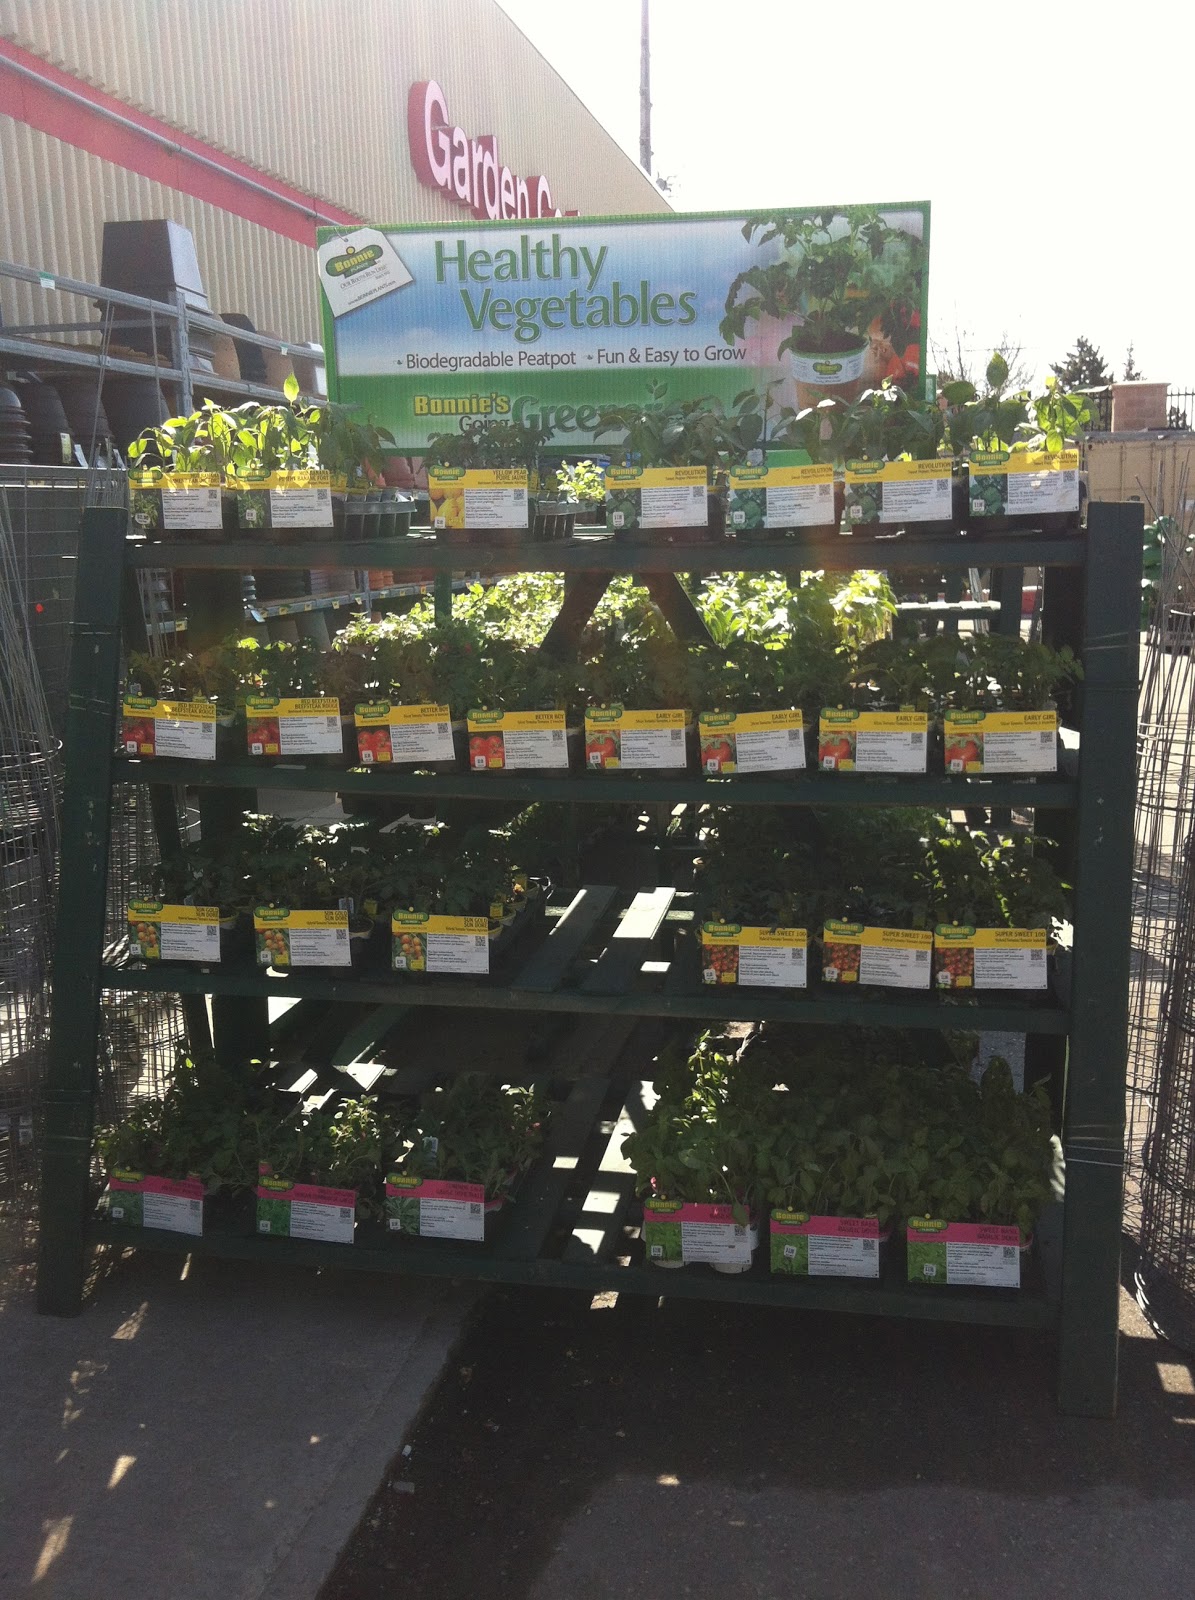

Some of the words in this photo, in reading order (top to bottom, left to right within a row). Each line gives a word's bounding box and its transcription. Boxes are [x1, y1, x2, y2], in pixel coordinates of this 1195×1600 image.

[424, 80, 530, 220] Garden
[334, 249, 375, 272] Bonnie
[434, 233, 609, 292] Healthy
[459, 279, 698, 343] Vegetables
[597, 348, 625, 364] Fun
[628, 348, 641, 363] &
[644, 347, 679, 366] Easy
[683, 348, 701, 362] to
[704, 346, 747, 361] Grow
[406, 352, 513, 371] Biodegradable
[518, 351, 577, 369] Peatpot
[414, 393, 510, 415] Bonnie's
[610, 468, 638, 476] Bonnie
[800, 467, 833, 475] REVOLUTION
[127, 697, 152, 705] Bonnie
[703, 714, 731, 722] Bonnie
[826, 710, 854, 718] Bonnie
[901, 931, 920, 939] SWEET
[391, 1176, 418, 1185] Bonnie
[649, 1200, 677, 1208] Bonnie
[775, 1211, 805, 1220] Bonnie
[912, 1219, 942, 1228] Bonnie
